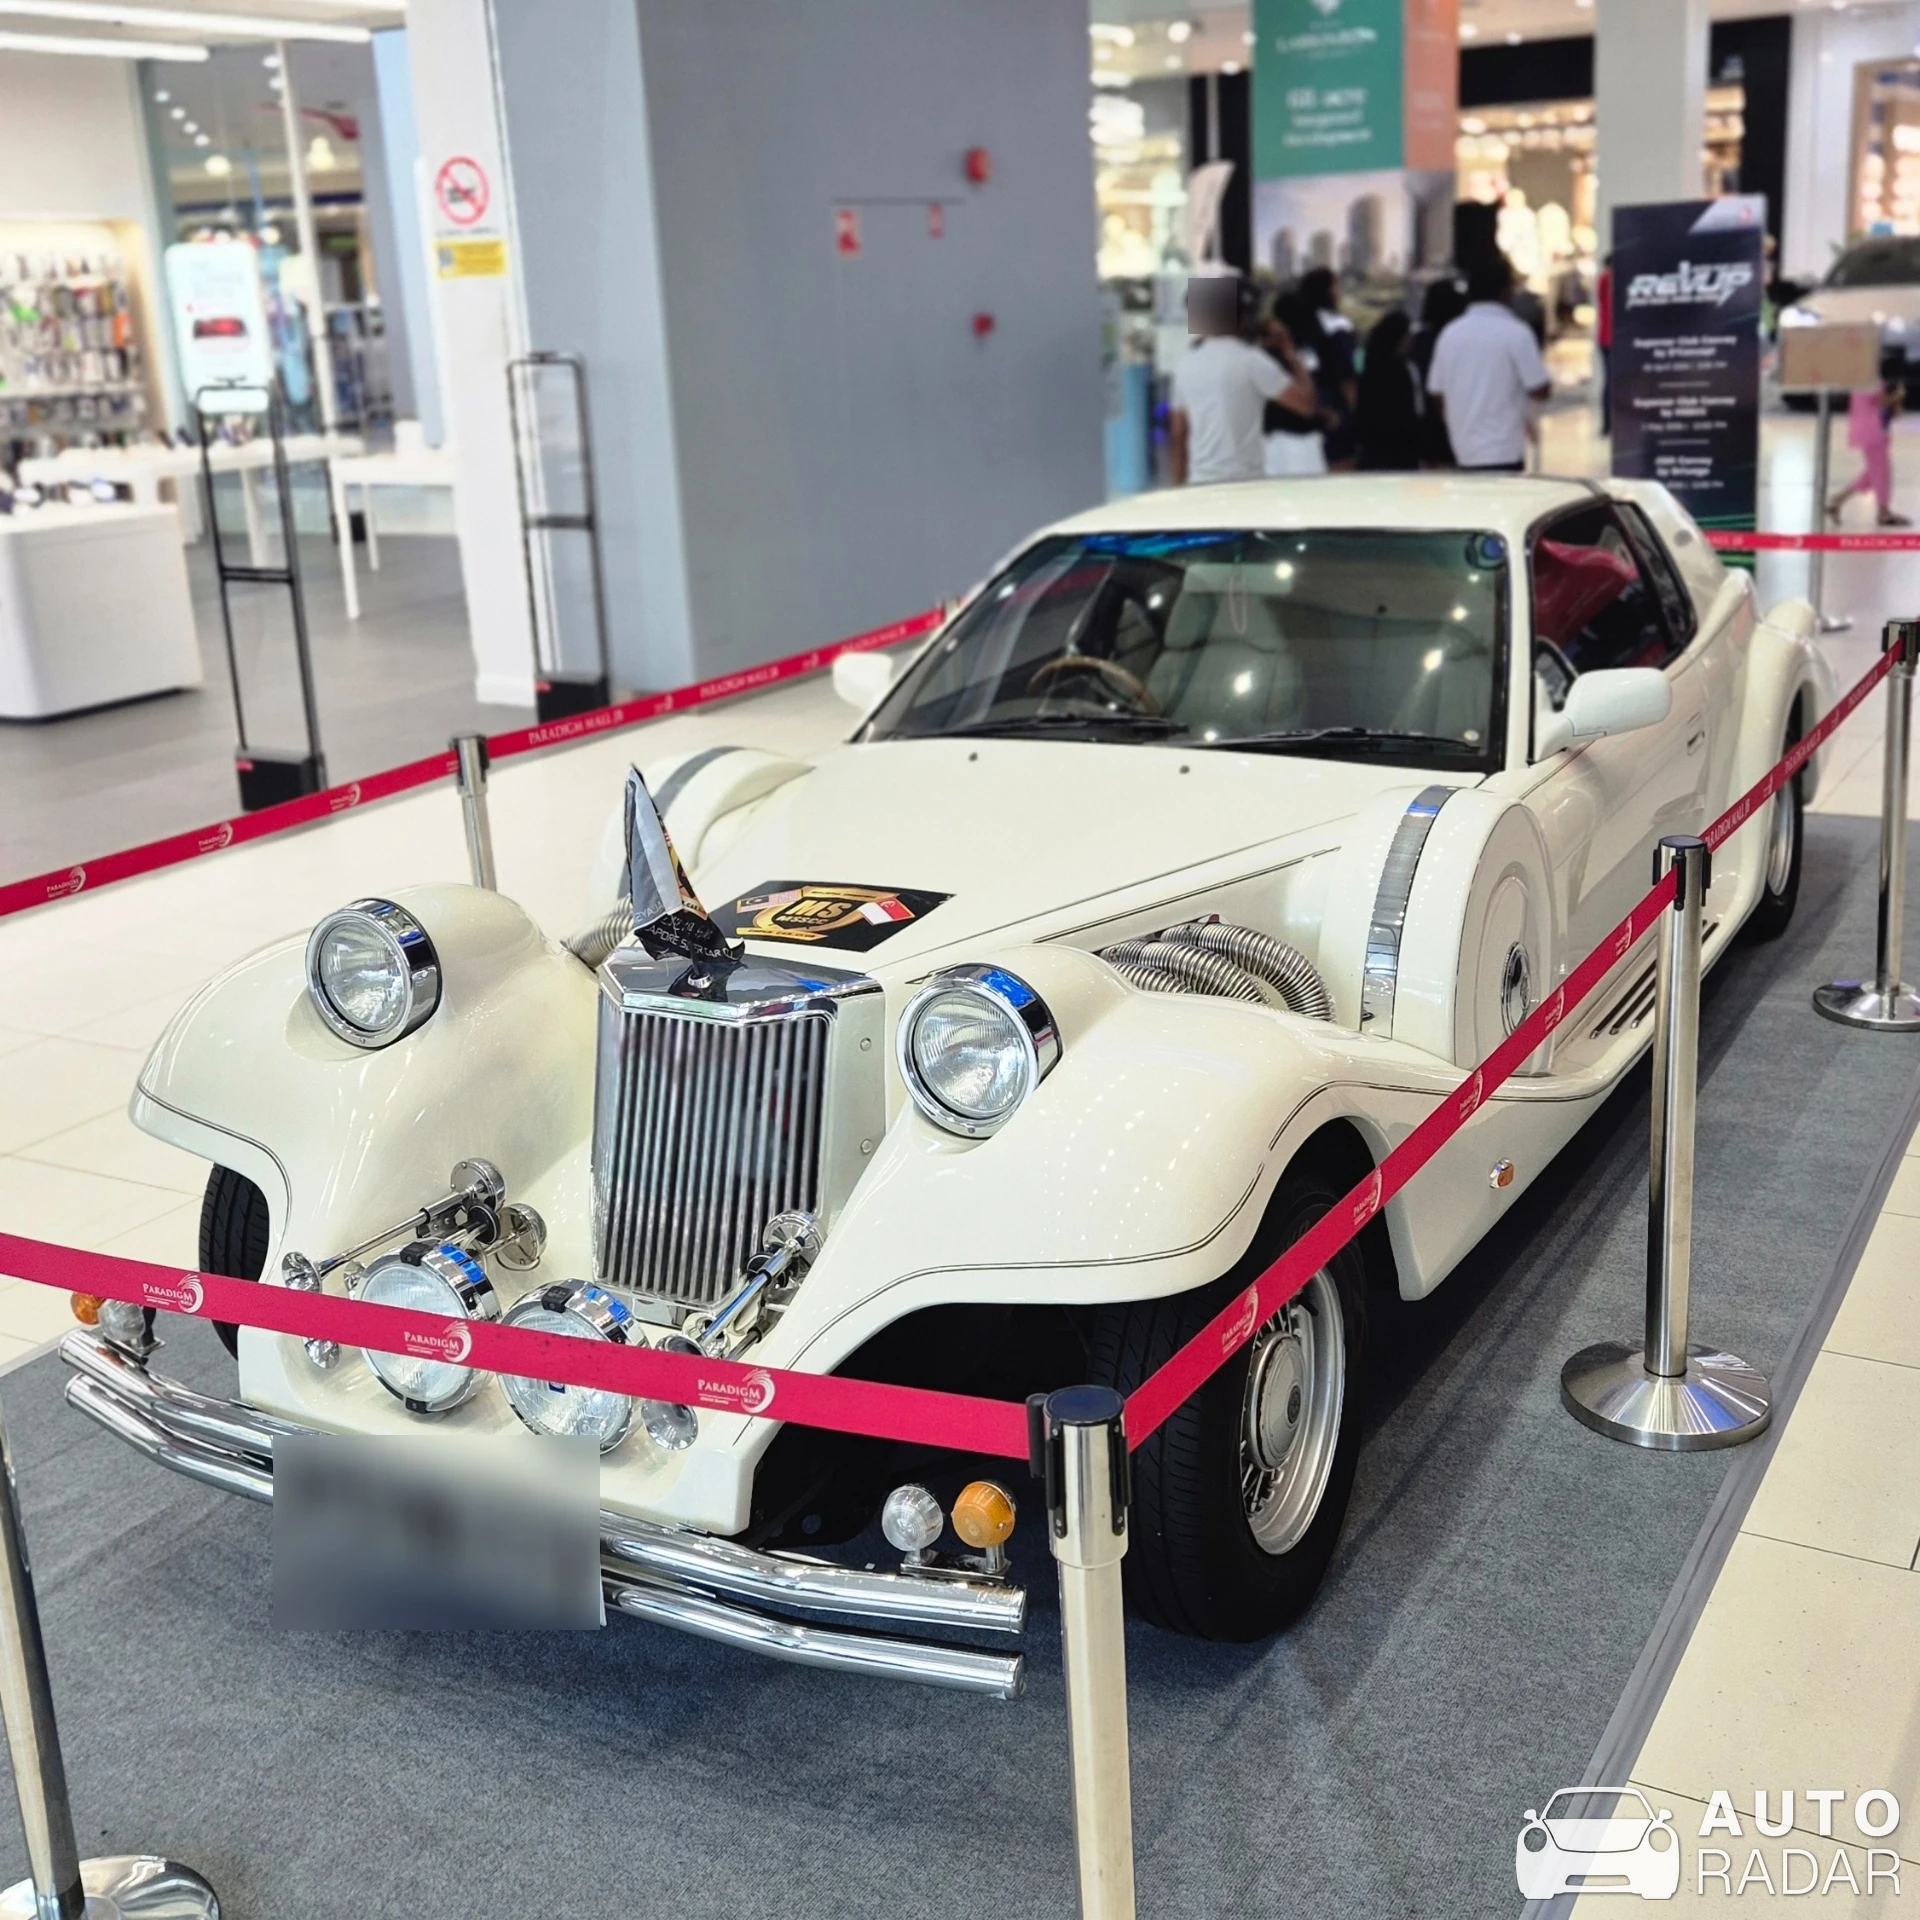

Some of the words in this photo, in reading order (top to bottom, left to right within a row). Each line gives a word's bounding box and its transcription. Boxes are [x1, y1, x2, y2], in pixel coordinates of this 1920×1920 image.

[528, 719, 584, 746] PARADIGM
[47, 877, 80, 893] PARADIGM
[784, 899, 853, 919] MS
[142, 1282, 194, 1303] PARADIGM
[1222, 1308, 1252, 1346] PARADIGM
[403, 1331, 460, 1352] PARADIGM
[697, 1379, 761, 1400] PARADIGM
